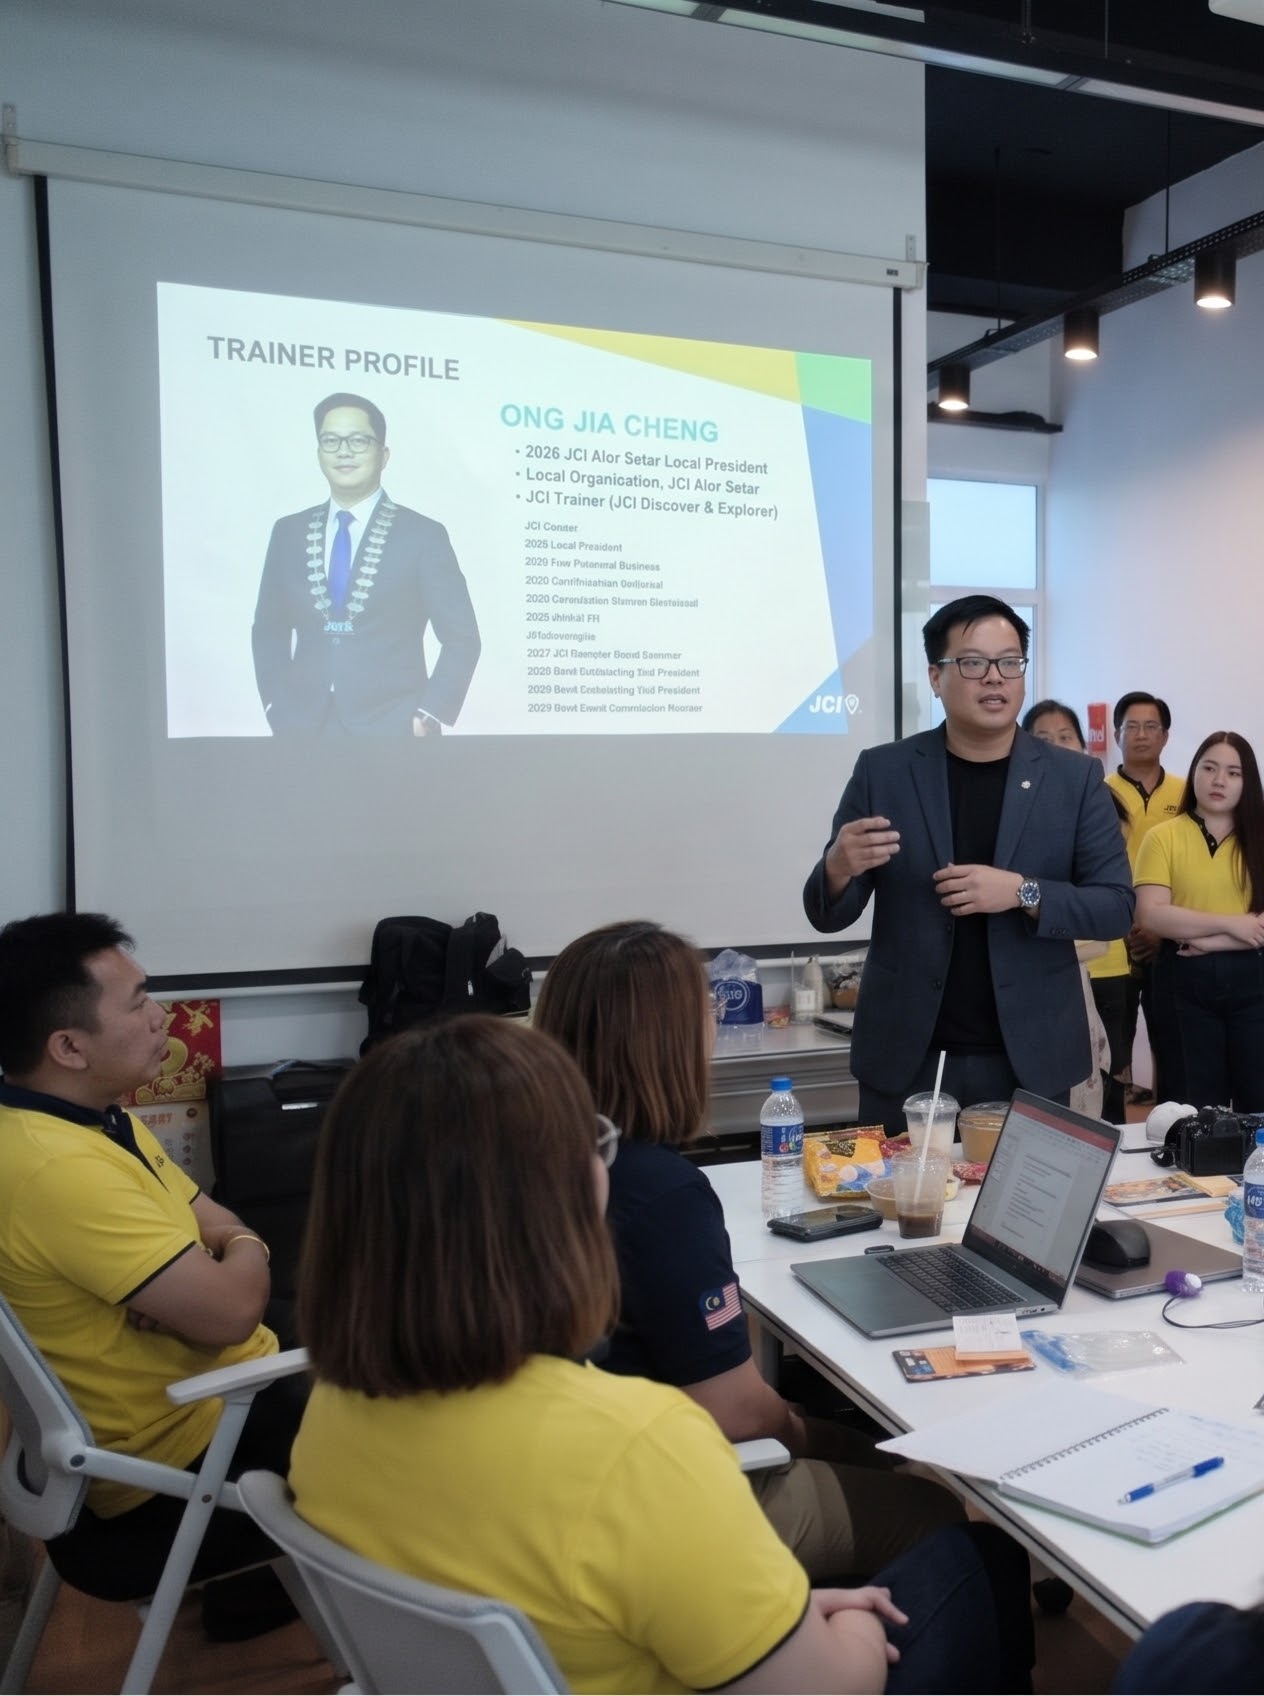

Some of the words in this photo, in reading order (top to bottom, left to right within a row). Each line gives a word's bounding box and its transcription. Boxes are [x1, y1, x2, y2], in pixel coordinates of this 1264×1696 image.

[207, 335, 336, 369] TRAINER
[344, 348, 460, 381] PROFILE
[500, 404, 564, 430] ONG
[573, 410, 616, 435] JIA
[624, 414, 719, 443] CHENG
[525, 445, 560, 460] 2026
[564, 447, 587, 462] JCI
[591, 449, 619, 464] Alor
[625, 452, 661, 467] Setar
[664, 454, 701, 470] Local
[705, 457, 768, 475] President
[526, 467, 565, 482] Local
[668, 476, 690, 491] JCI
[694, 478, 721, 493] Alor
[725, 480, 760, 495] Setar
[525, 490, 550, 504] JCI
[554, 492, 605, 507] Trainer
[609, 494, 637, 511] (JCI
[640, 496, 700, 513] Discover
[704, 500, 714, 514] &
[718, 501, 779, 521] Explorer)
[525, 521, 541, 531] JCI
[551, 540, 576, 550] Local
[553, 648, 569, 658] JCI
[809, 695, 843, 714] JCI
